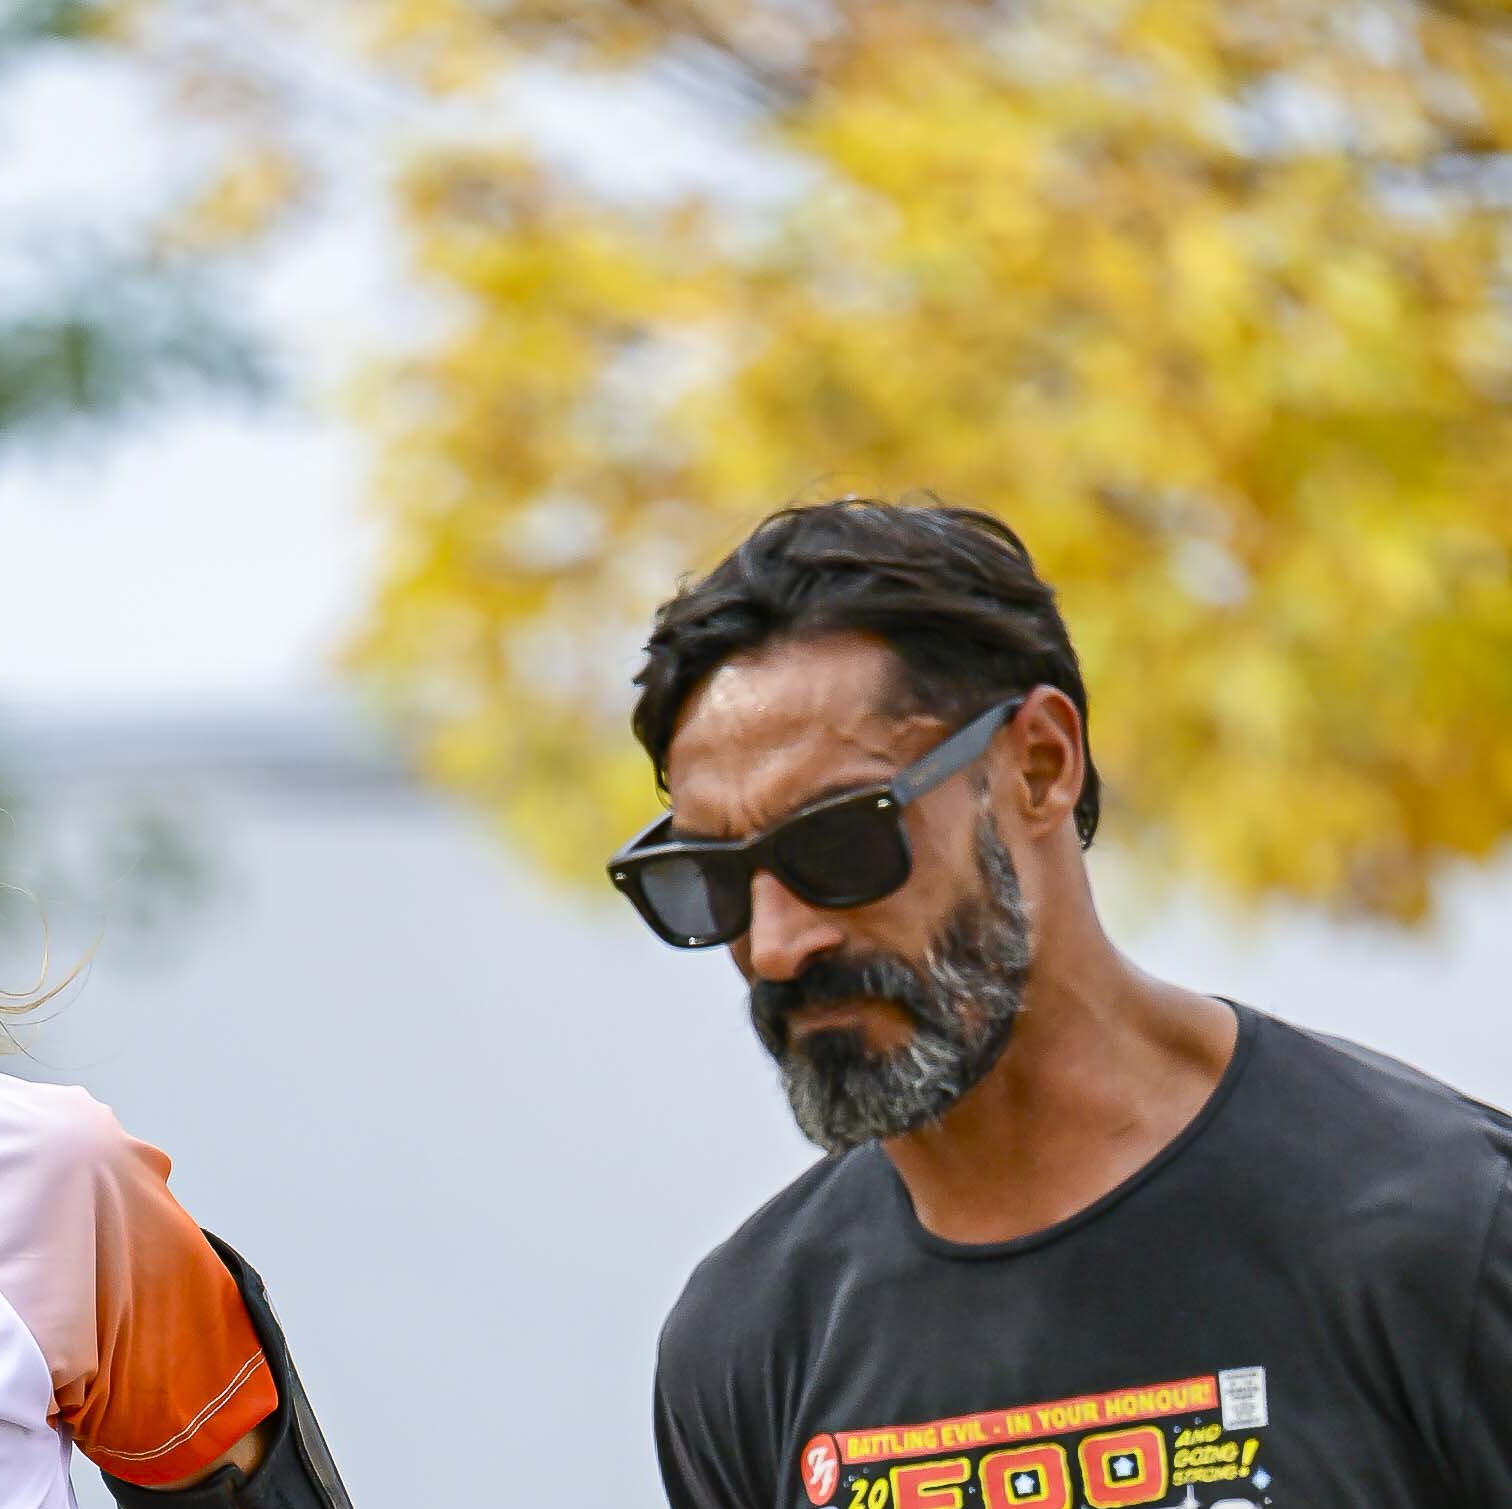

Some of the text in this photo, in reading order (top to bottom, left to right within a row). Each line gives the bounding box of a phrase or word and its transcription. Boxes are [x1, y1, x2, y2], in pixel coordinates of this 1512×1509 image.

[848, 1429, 938, 1458] BATTLING
[941, 1420, 986, 1446] EVIL
[1005, 1411, 1032, 1435] IN
[1038, 1401, 1099, 1430] YOUR
